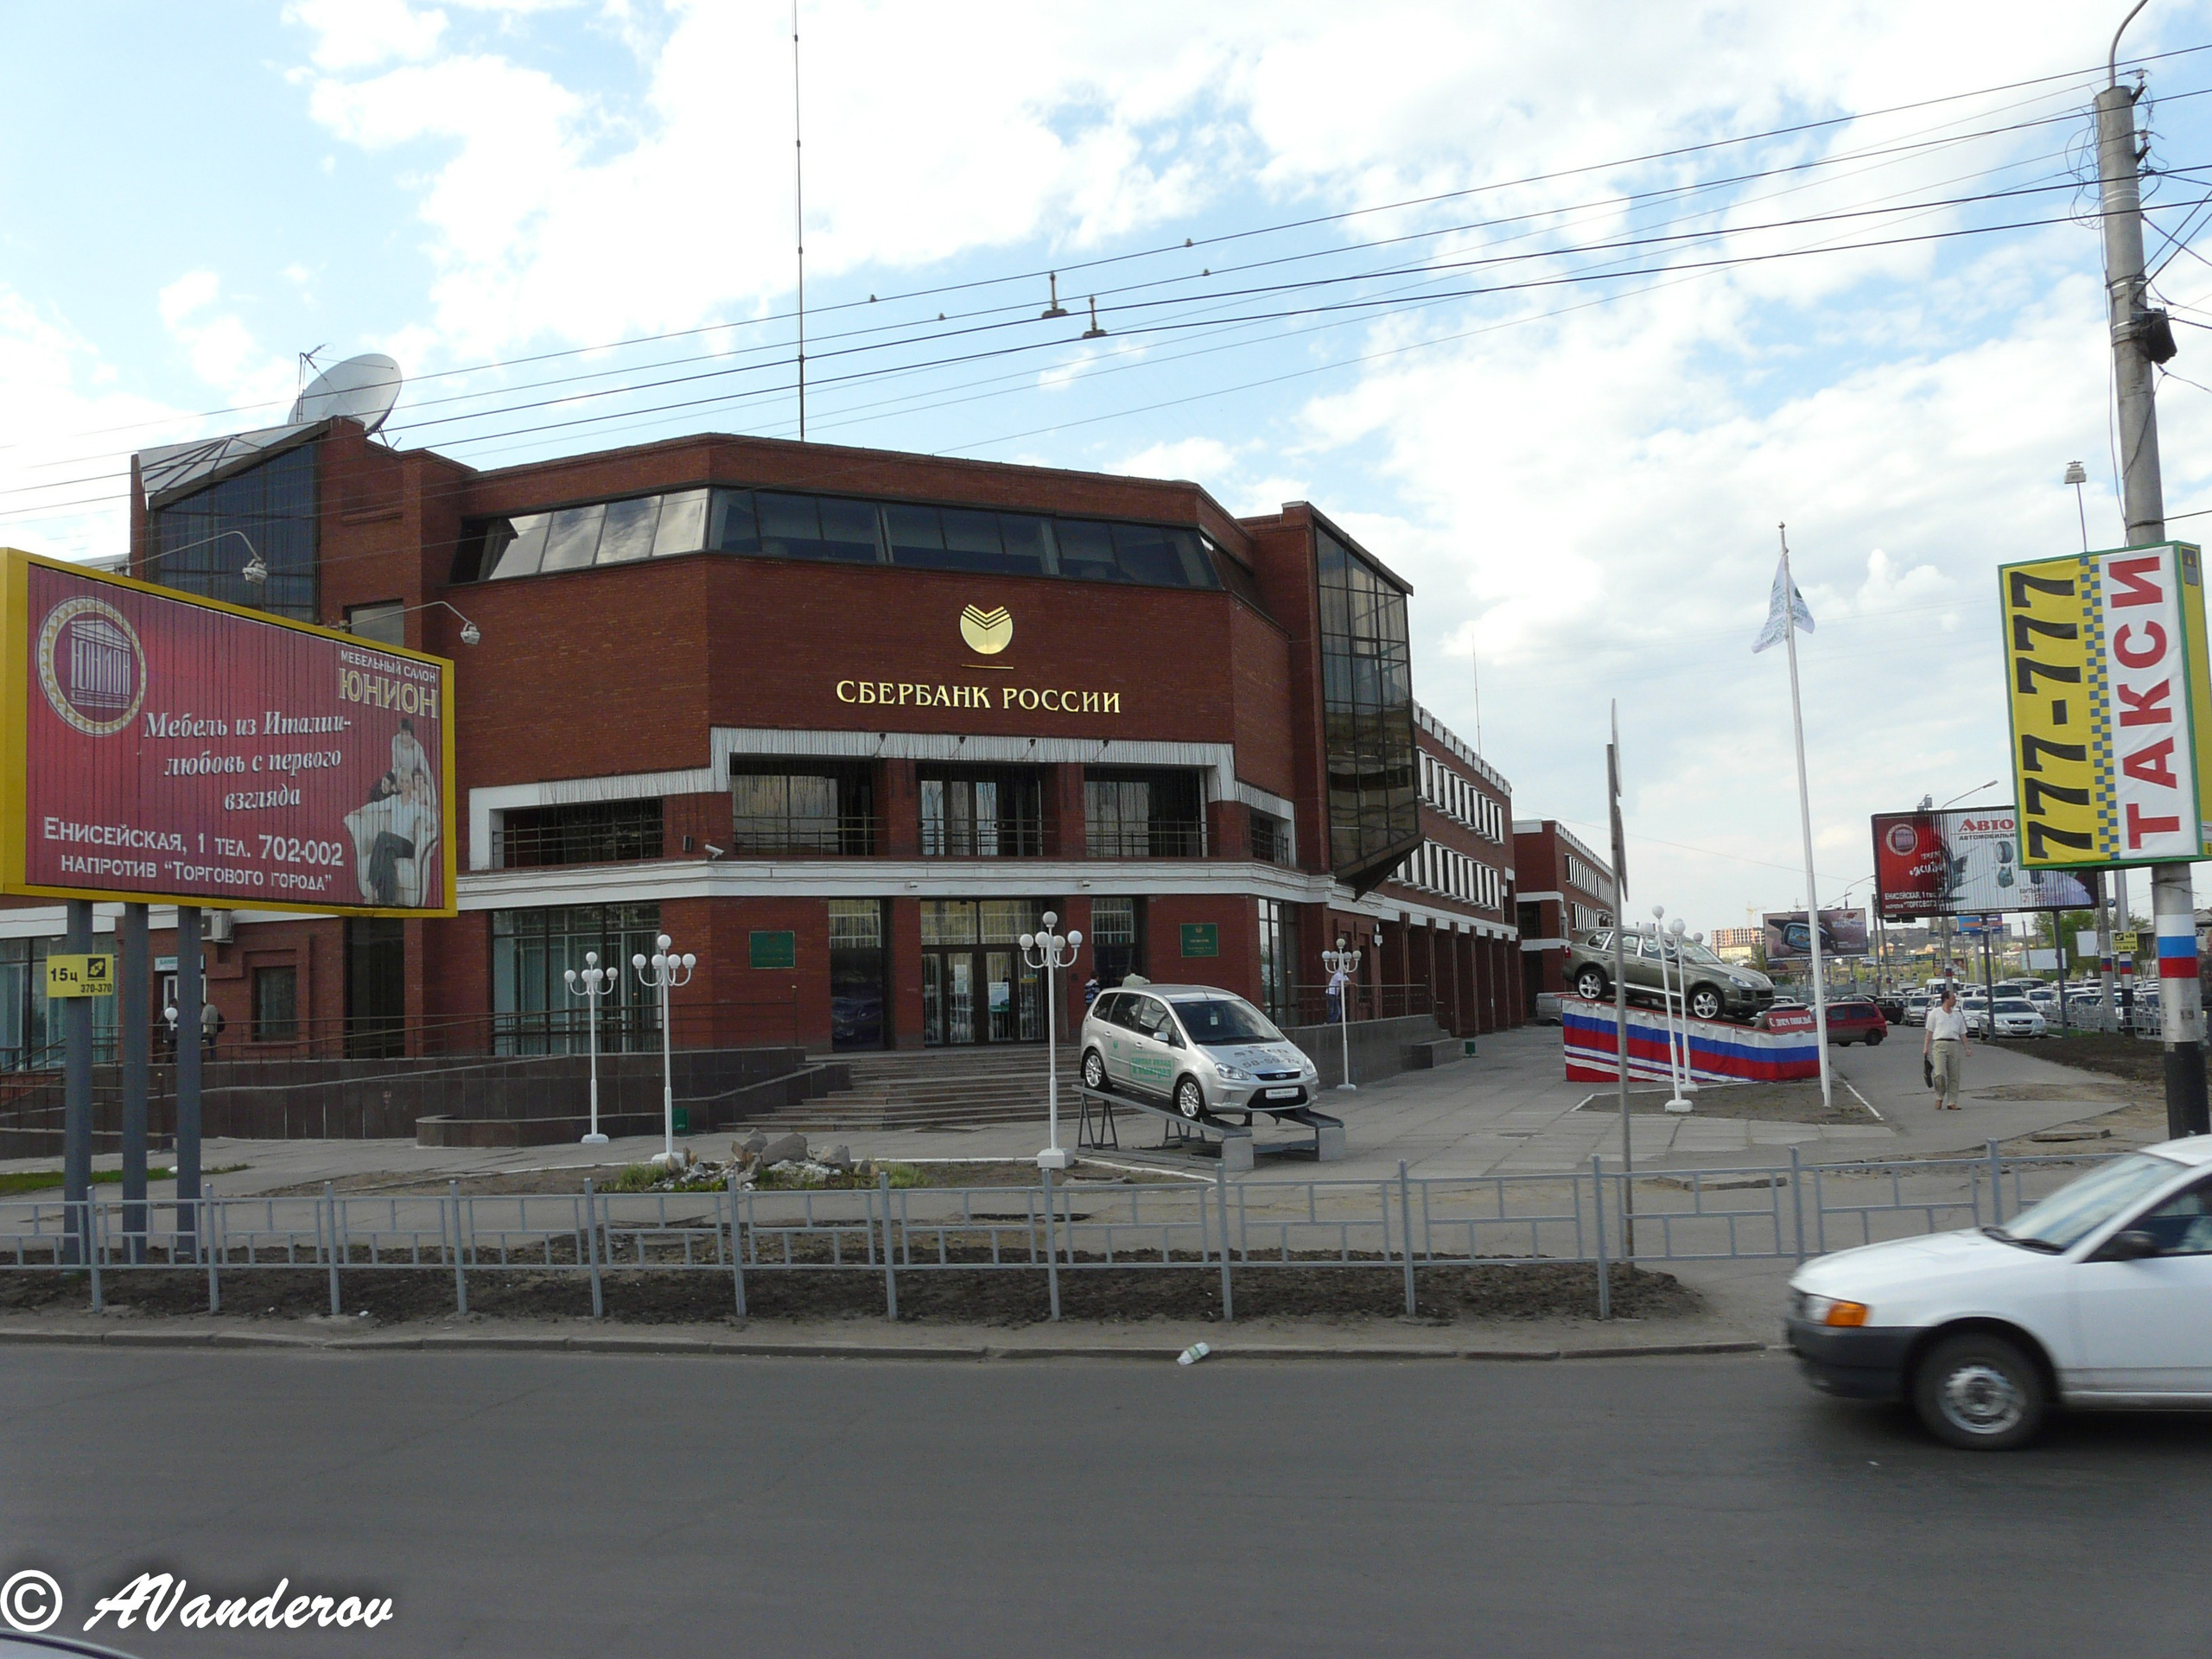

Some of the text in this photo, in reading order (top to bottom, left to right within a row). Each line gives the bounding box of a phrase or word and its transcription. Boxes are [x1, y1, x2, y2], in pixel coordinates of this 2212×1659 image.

[340, 650, 436, 683] МЕБЕЛЬНЫЙ САЛОН
[339, 668, 439, 719] ЮНИОН
[836, 680, 1121, 713] СБЕРБАНК РОССИИ
[2107, 556, 2181, 849] ТАКСИ
[143, 711, 352, 738] Мебель из Италии-
[2010, 571, 2093, 858] 777-777
[164, 750, 341, 777] любовь с первого
[225, 783, 301, 810] взгляда
[43, 816, 344, 867] ЕНИСЕЙСКАЯ, 1 ТЕЛ. 702-002
[60, 855, 157, 878] НАПРОТИВ
[81, 982, 112, 994] 370-370
